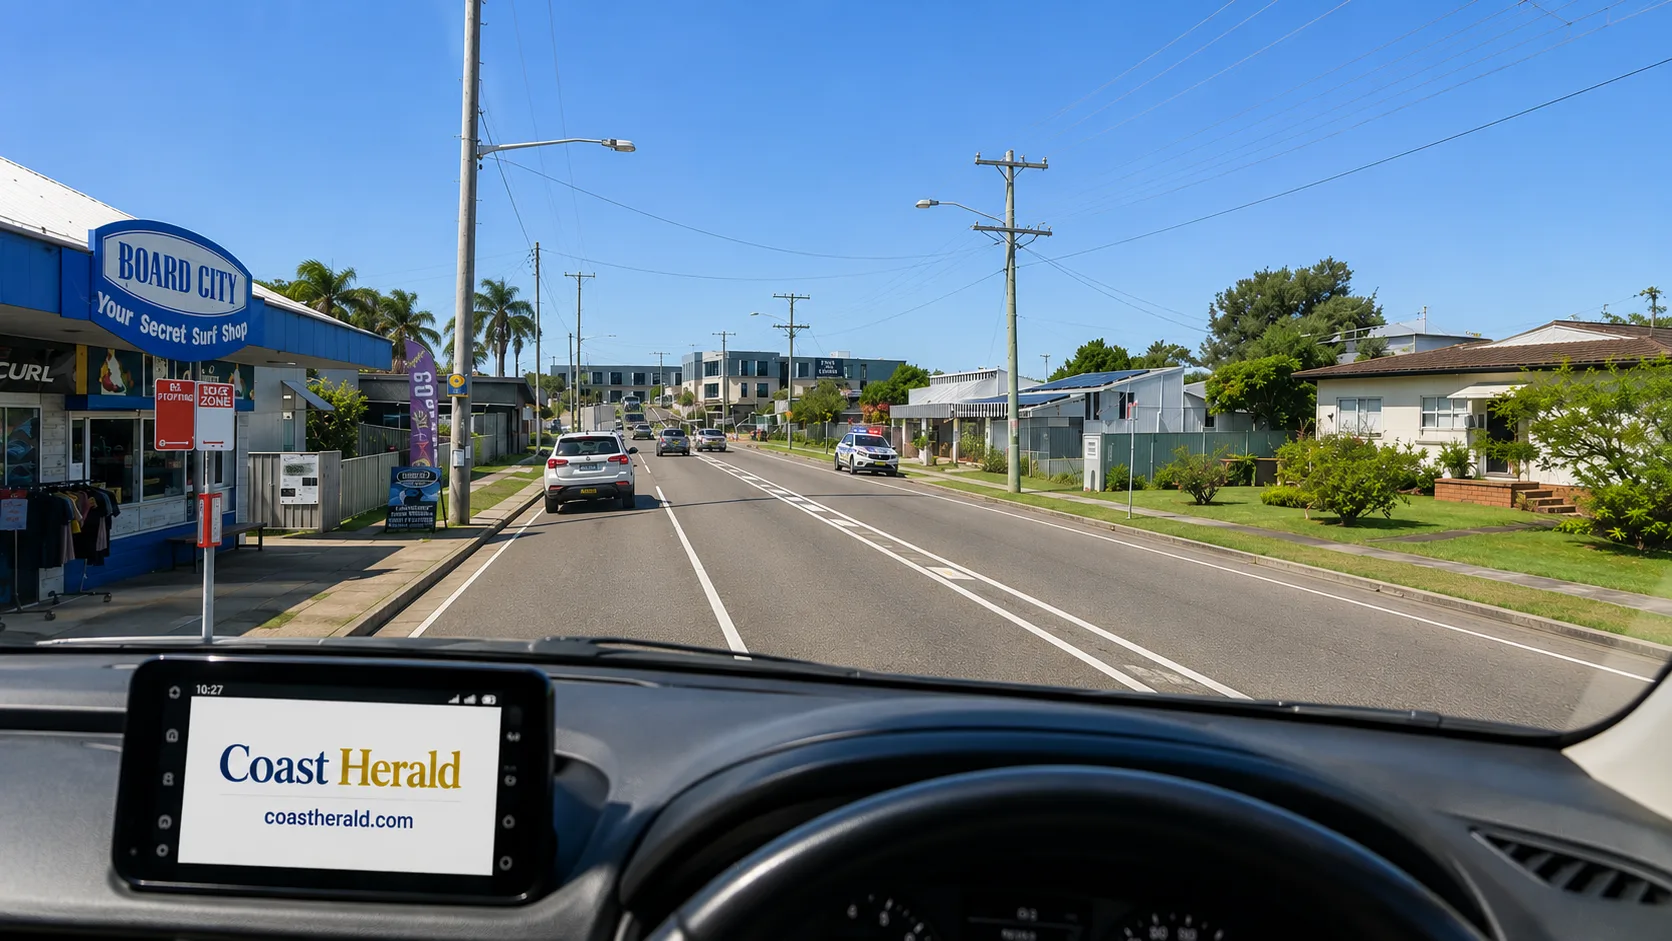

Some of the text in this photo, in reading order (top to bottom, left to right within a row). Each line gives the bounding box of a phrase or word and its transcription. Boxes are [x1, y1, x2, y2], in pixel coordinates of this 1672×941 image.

[118, 241, 237, 305] BOARD CITY
[97, 291, 247, 345] Your Secret Surf Shop
[200, 396, 231, 407] ZONE
[196, 684, 224, 696] 10:27
[220, 744, 461, 789] Coast Herald
[264, 808, 413, 829] coastherald.com
